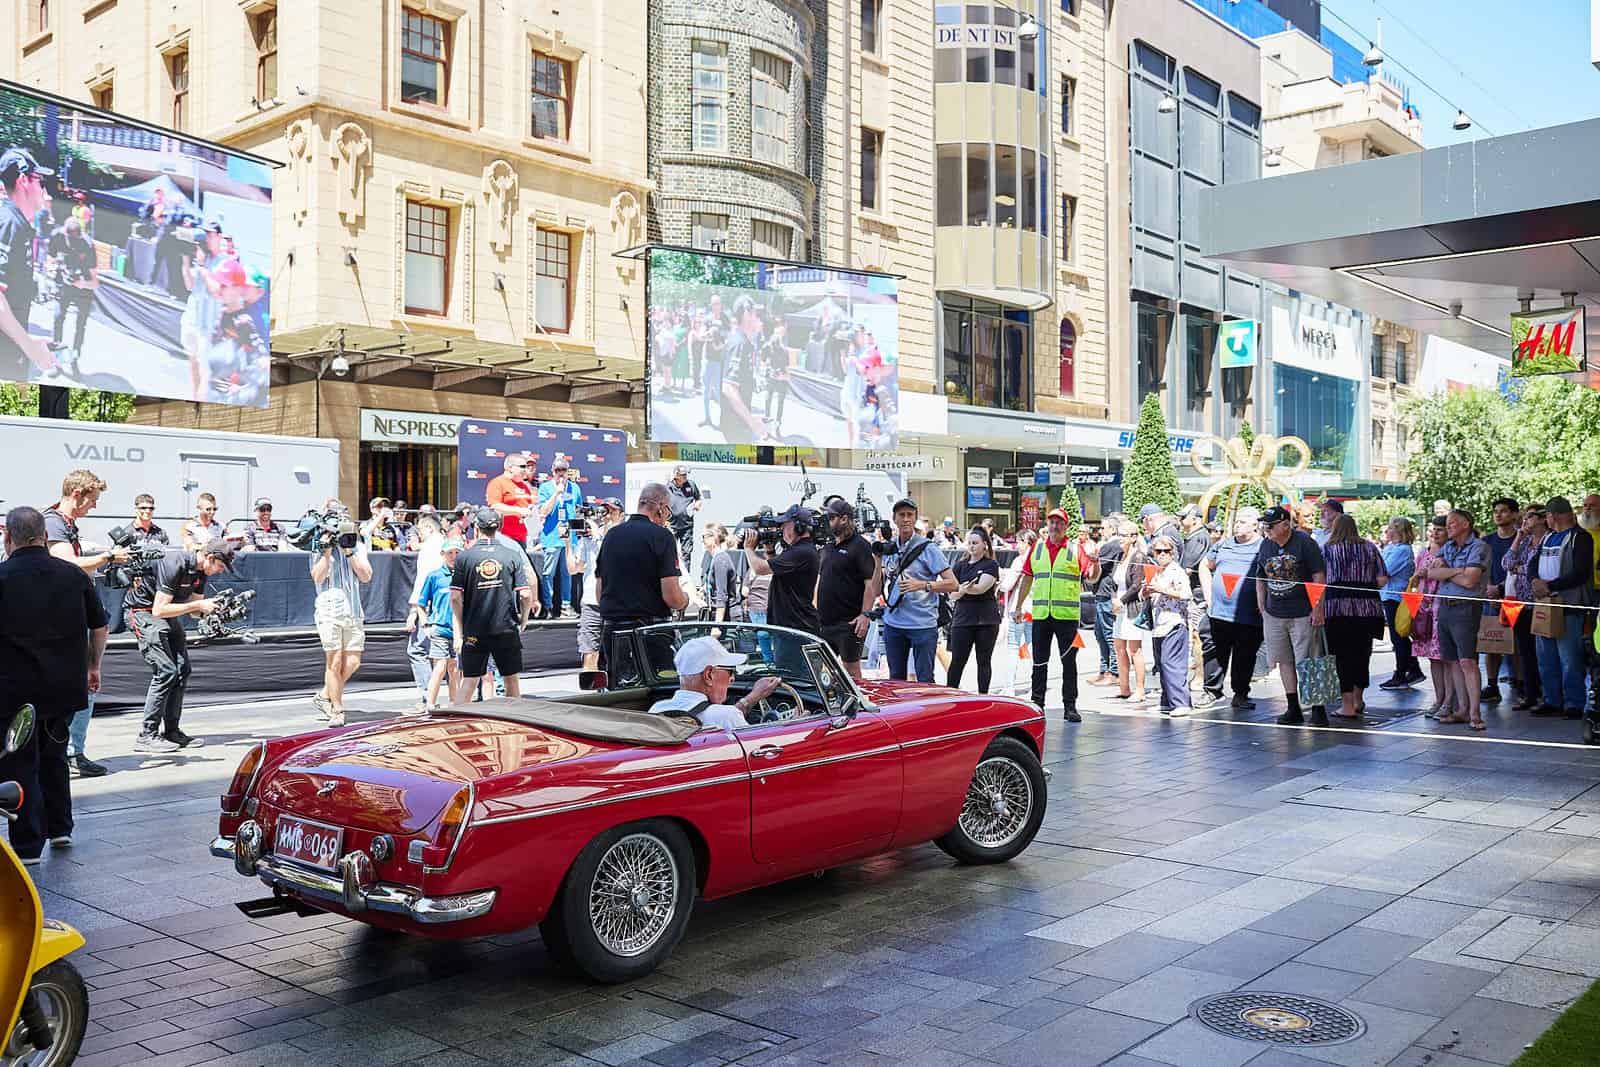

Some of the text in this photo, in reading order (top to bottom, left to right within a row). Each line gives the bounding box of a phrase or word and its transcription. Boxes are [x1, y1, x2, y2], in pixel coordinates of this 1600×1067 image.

[939, 28, 1015, 46] DENTIST
[1518, 320, 1576, 360] H&M
[373, 414, 459, 438] NESPRESS
[64, 443, 145, 463] VAILO
[866, 461, 923, 470] SPORTSCRAFT
[311, 832, 337, 860] 069
